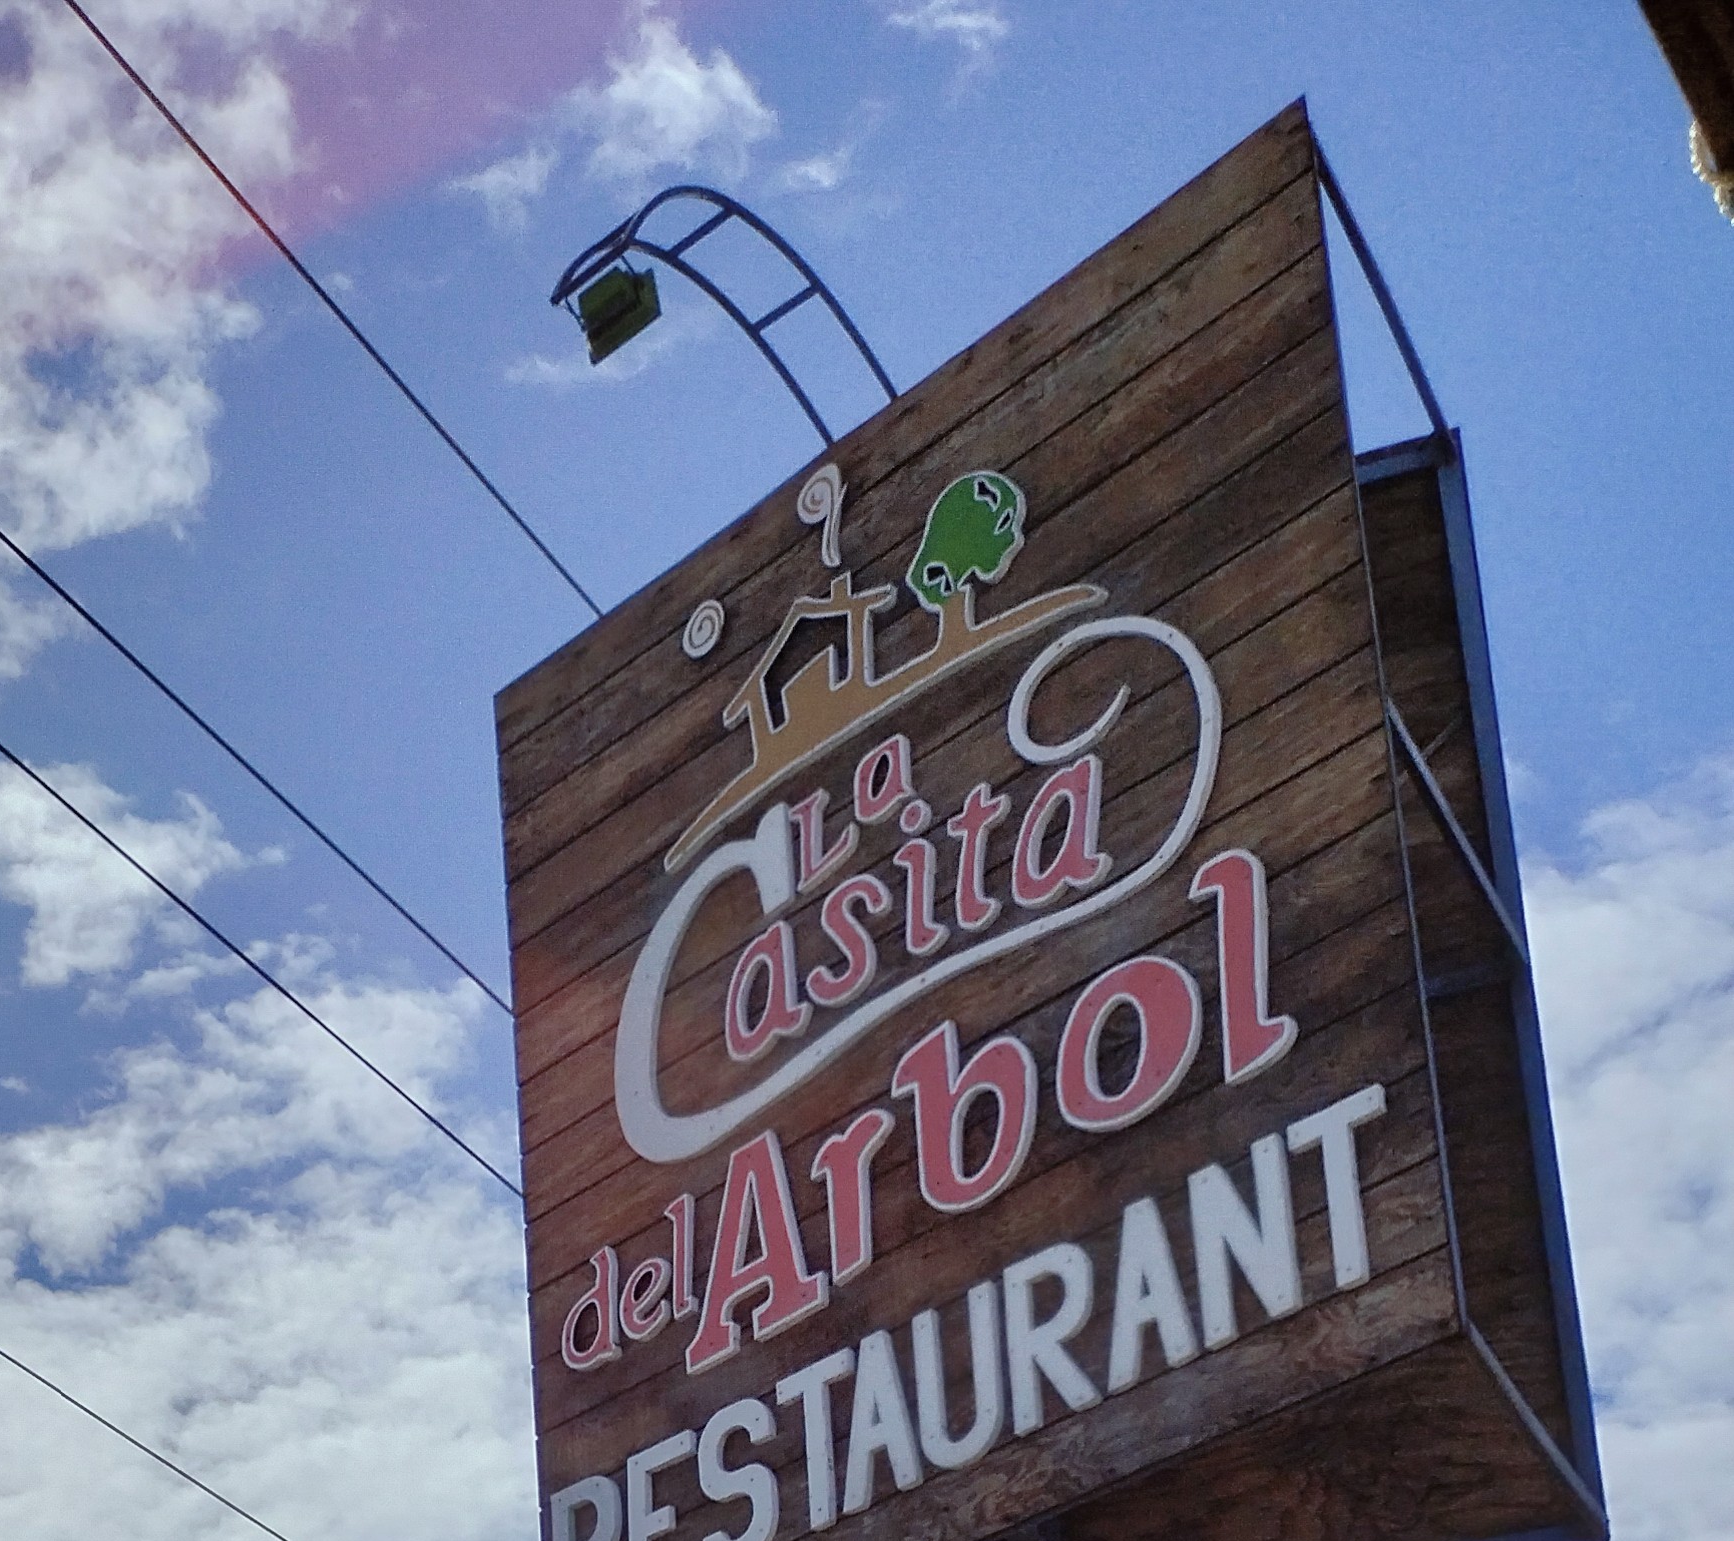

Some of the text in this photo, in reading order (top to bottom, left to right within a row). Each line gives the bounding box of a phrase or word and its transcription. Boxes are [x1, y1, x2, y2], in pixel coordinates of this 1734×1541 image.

[613, 616, 1223, 1164] Casita
[791, 733, 914, 891] La
[560, 847, 1300, 1376] del Arbol
